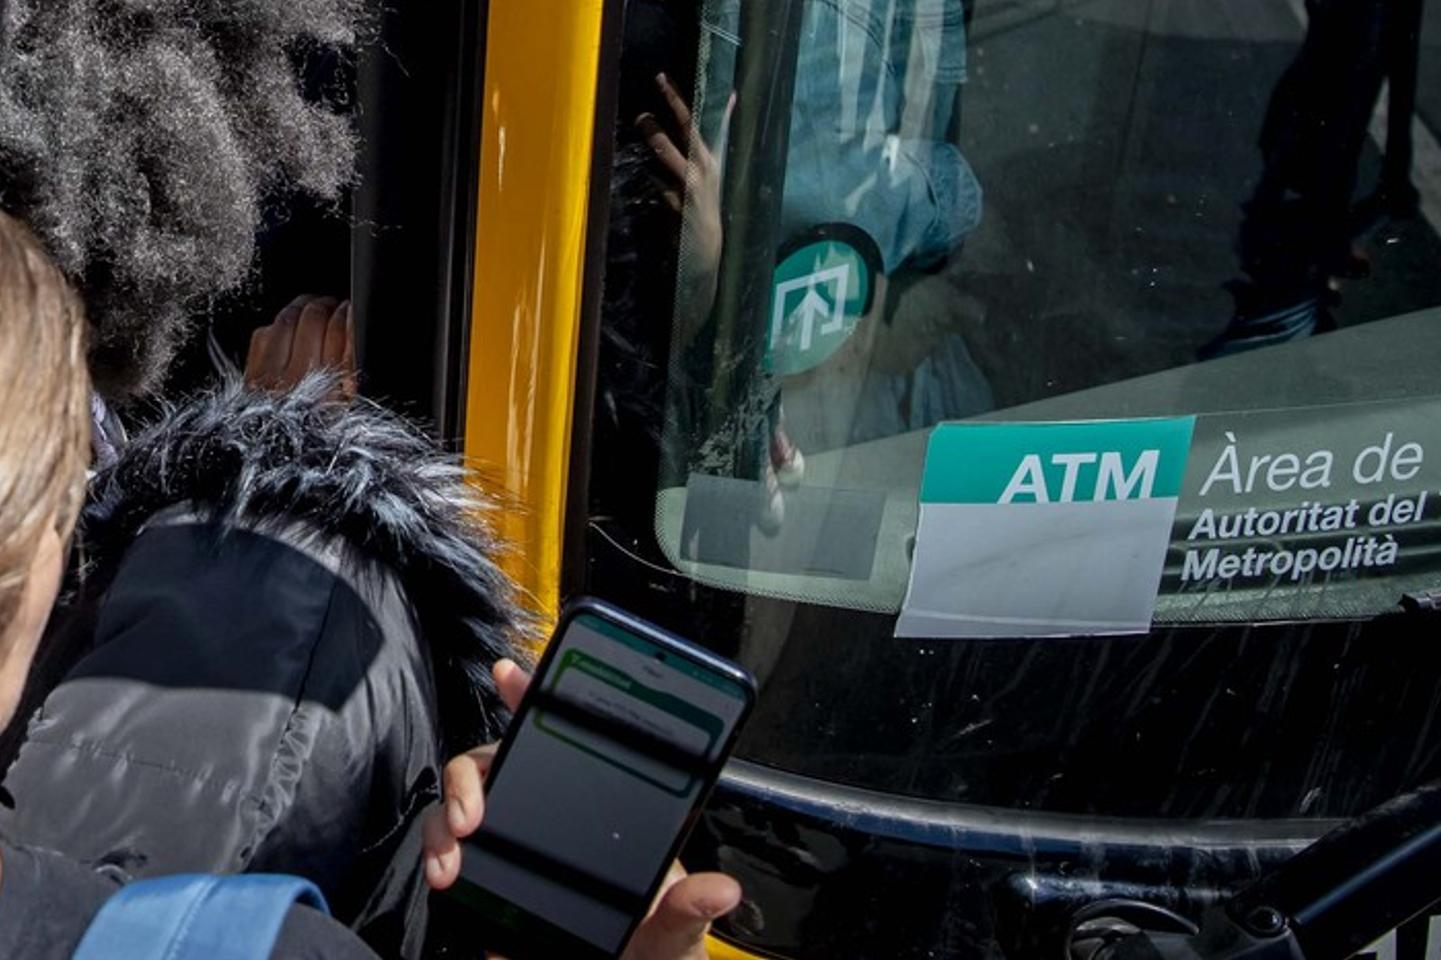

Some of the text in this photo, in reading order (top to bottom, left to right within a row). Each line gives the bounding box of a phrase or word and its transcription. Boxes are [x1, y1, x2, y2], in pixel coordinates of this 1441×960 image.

[997, 449, 1160, 504] ATM
[1199, 431, 1424, 497] Àrea de
[1188, 490, 1428, 541] Autoritat del
[1180, 534, 1399, 581] Metropolità
